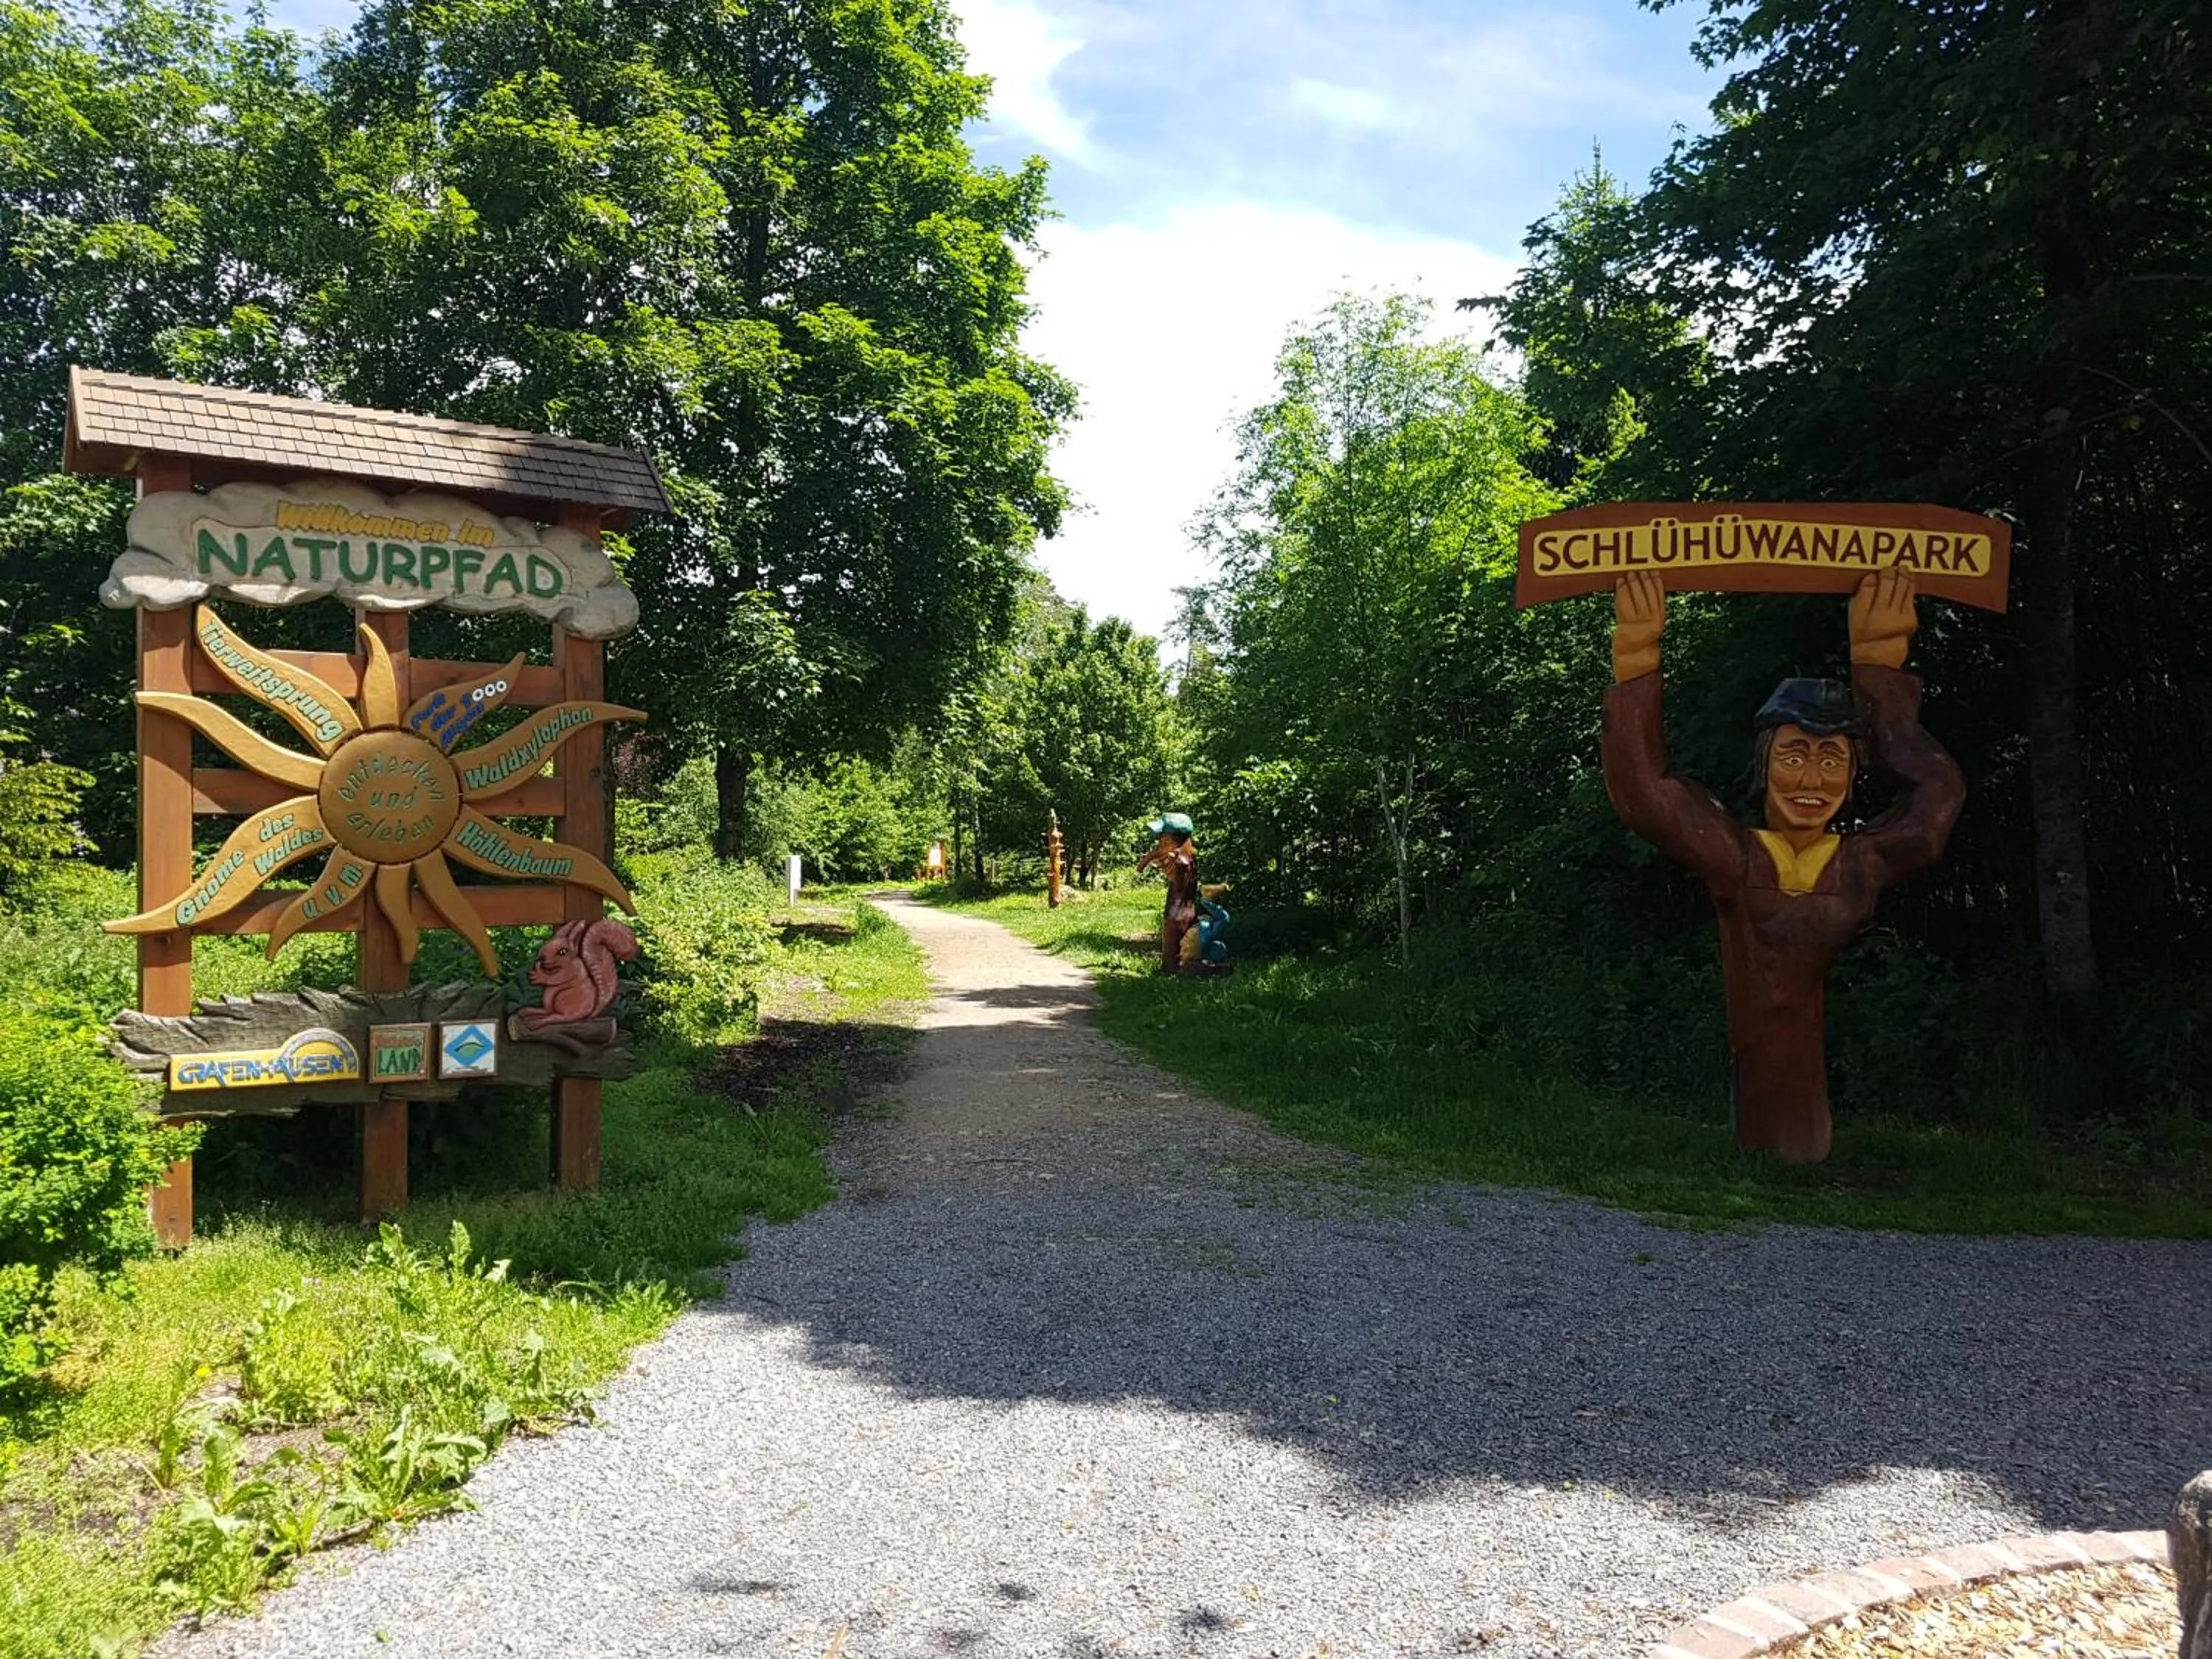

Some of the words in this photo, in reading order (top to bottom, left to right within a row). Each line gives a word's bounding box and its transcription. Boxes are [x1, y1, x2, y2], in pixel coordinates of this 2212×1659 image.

[277, 501, 450, 543] Willkommen
[458, 519, 495, 546] im
[1538, 518, 1984, 572] SCHLÜHÜWANAPARK
[197, 529, 563, 598] NATURPFAD
[200, 619, 343, 742] Tierweitsprung
[466, 707, 592, 788] Waldxylophon
[338, 752, 445, 801] entdecken
[370, 786, 418, 810] und
[254, 827, 324, 876] Waldes
[260, 813, 294, 842] des
[347, 813, 434, 844] erleben
[456, 821, 572, 876] Höhlenbaum
[175, 849, 244, 925] Gnome
[378, 1048, 422, 1075] LAND
